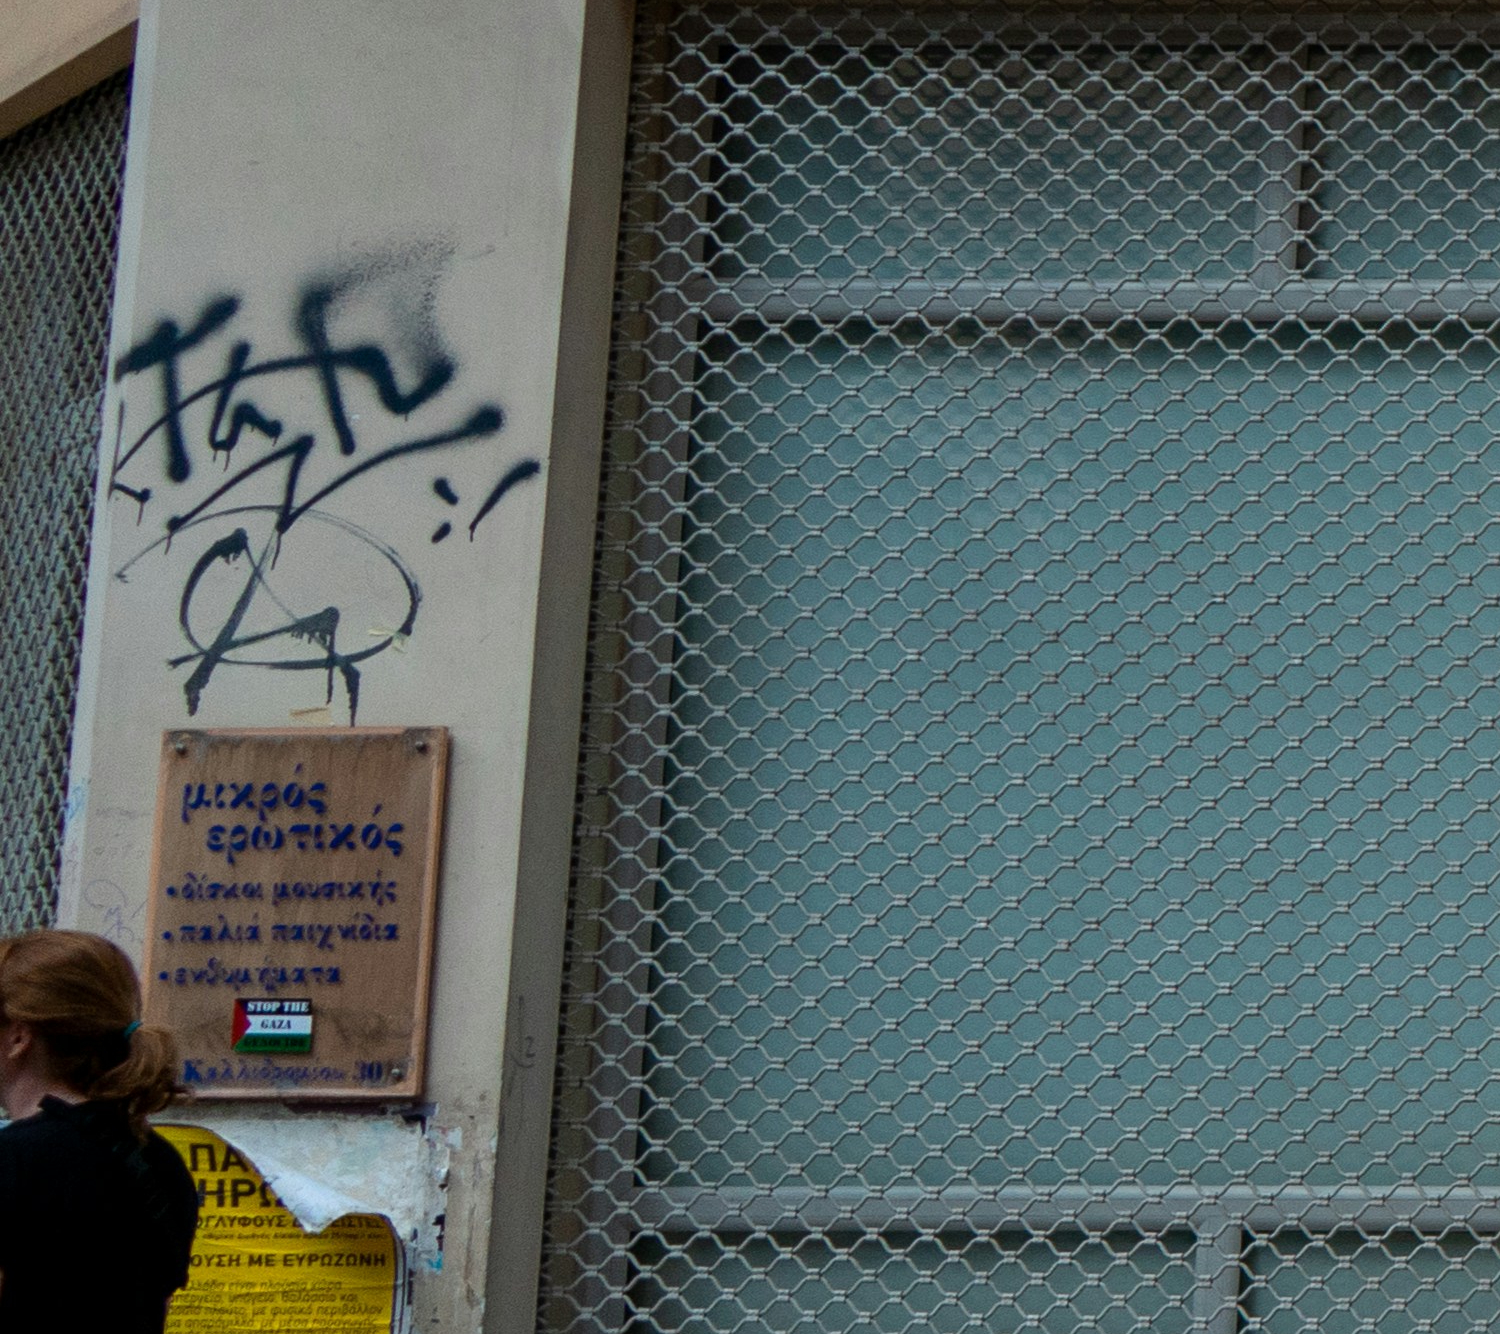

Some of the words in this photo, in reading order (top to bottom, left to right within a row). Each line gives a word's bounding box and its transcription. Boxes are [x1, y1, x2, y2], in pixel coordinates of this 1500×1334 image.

[181, 763, 328, 824] μικρός
[207, 804, 405, 865] ερωτικός
[271, 869, 397, 907] μουσικής
[180, 914, 260, 942] παλιά
[246, 1001, 281, 1013] STOP
[283, 1001, 310, 1013] THE
[260, 1019, 292, 1030] GAZA
[195, 1215, 292, 1229] ΟΓΛΥΦΟΥΣ
[190, 1254, 241, 1267] ΟΥΣΗ
[248, 1254, 276, 1267] ΜΕ
[282, 1253, 386, 1267] ΕΥΡΩΖΩΝΗ
